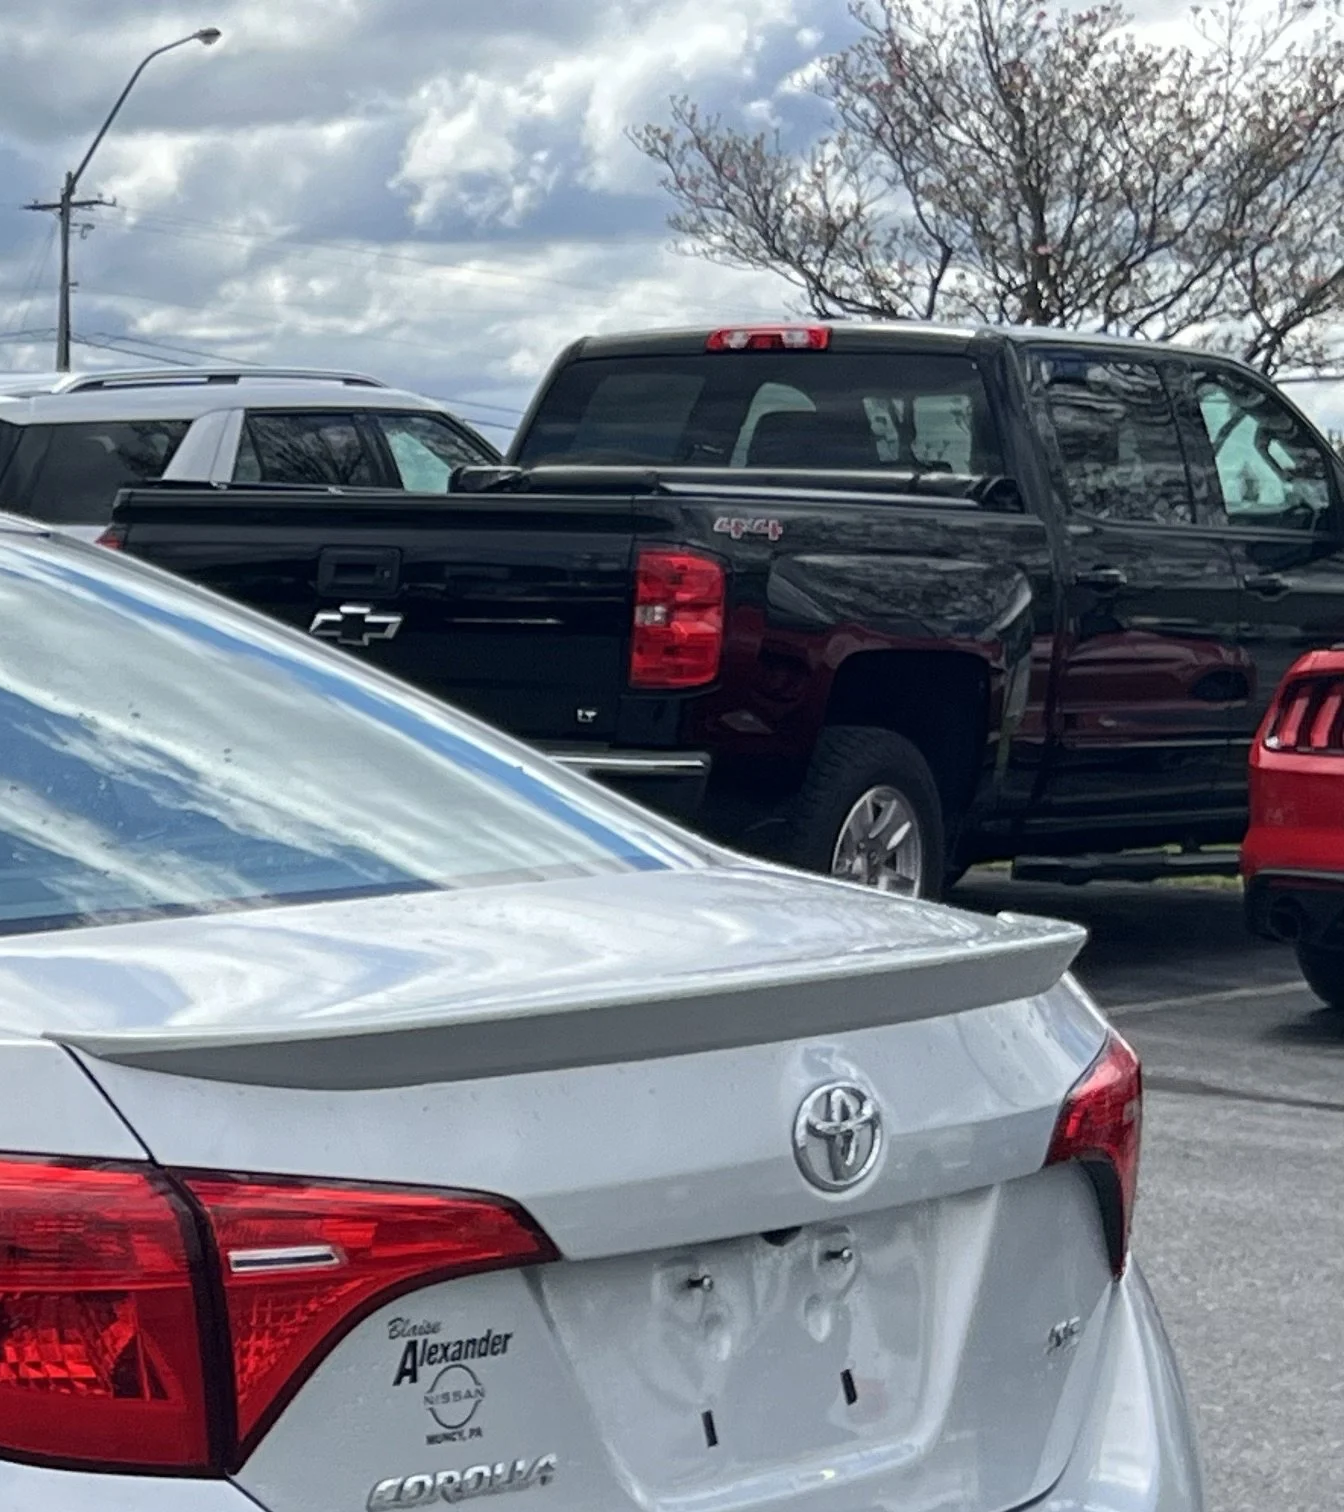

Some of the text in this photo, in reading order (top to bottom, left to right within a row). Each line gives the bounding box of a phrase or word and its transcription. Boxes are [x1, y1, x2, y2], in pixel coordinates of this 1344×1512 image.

[577, 708, 597, 723] LT
[387, 1317, 443, 1340] Blaise
[392, 1328, 514, 1387] Alexander
[423, 1387, 486, 1405] NISSAN
[365, 1452, 558, 1512] COROLLA
